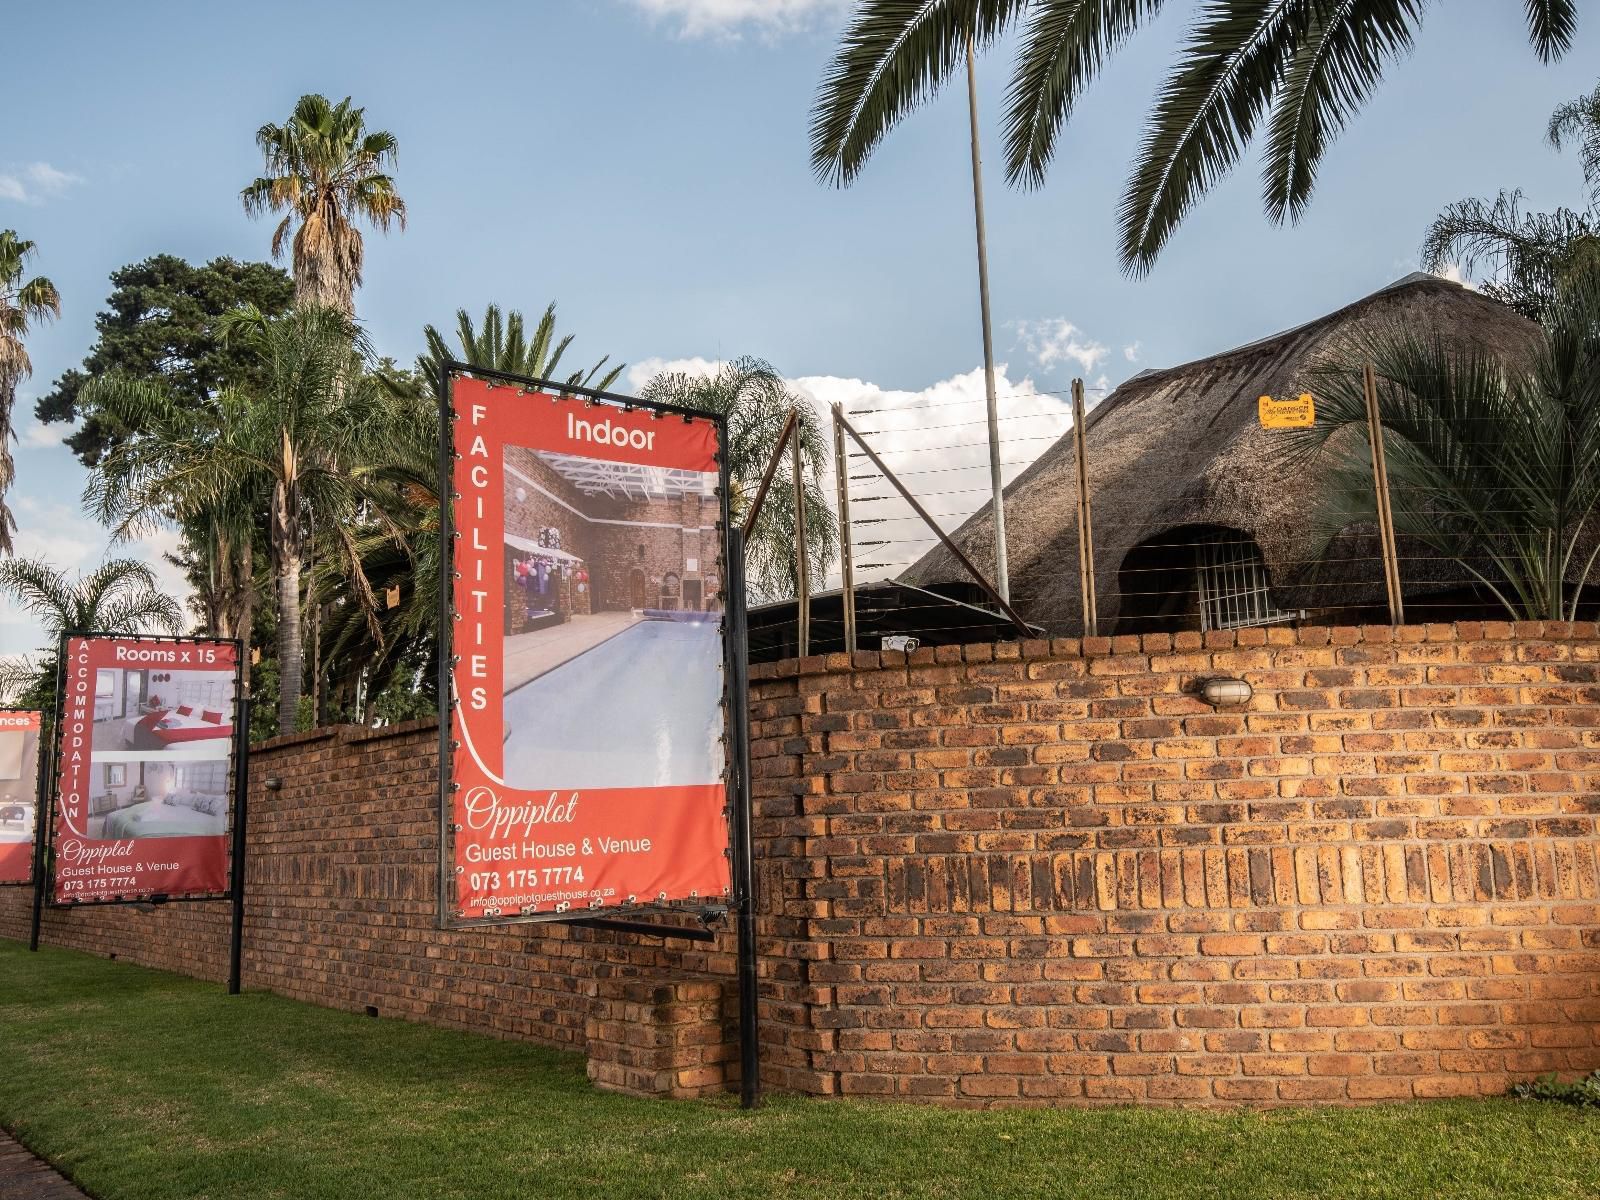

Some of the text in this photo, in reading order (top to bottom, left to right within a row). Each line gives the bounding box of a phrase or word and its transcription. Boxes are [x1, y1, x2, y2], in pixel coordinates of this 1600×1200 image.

[568, 412, 656, 450] Indoor
[470, 404, 489, 710] FACILITIES
[116, 646, 216, 663] Rooms x 15
[68, 640, 89, 818] ACCOMMODATION
[465, 786, 579, 839] Oppiplot
[63, 839, 135, 865] Oppiplot
[465, 836, 652, 863] Guest House & Venue
[62, 862, 180, 877] Guest House & Venue
[470, 866, 585, 891] 073 175 7774
[63, 876, 137, 891] 073 175 7774
[470, 887, 615, 908] info@oppiplotguesthouse.co.za
